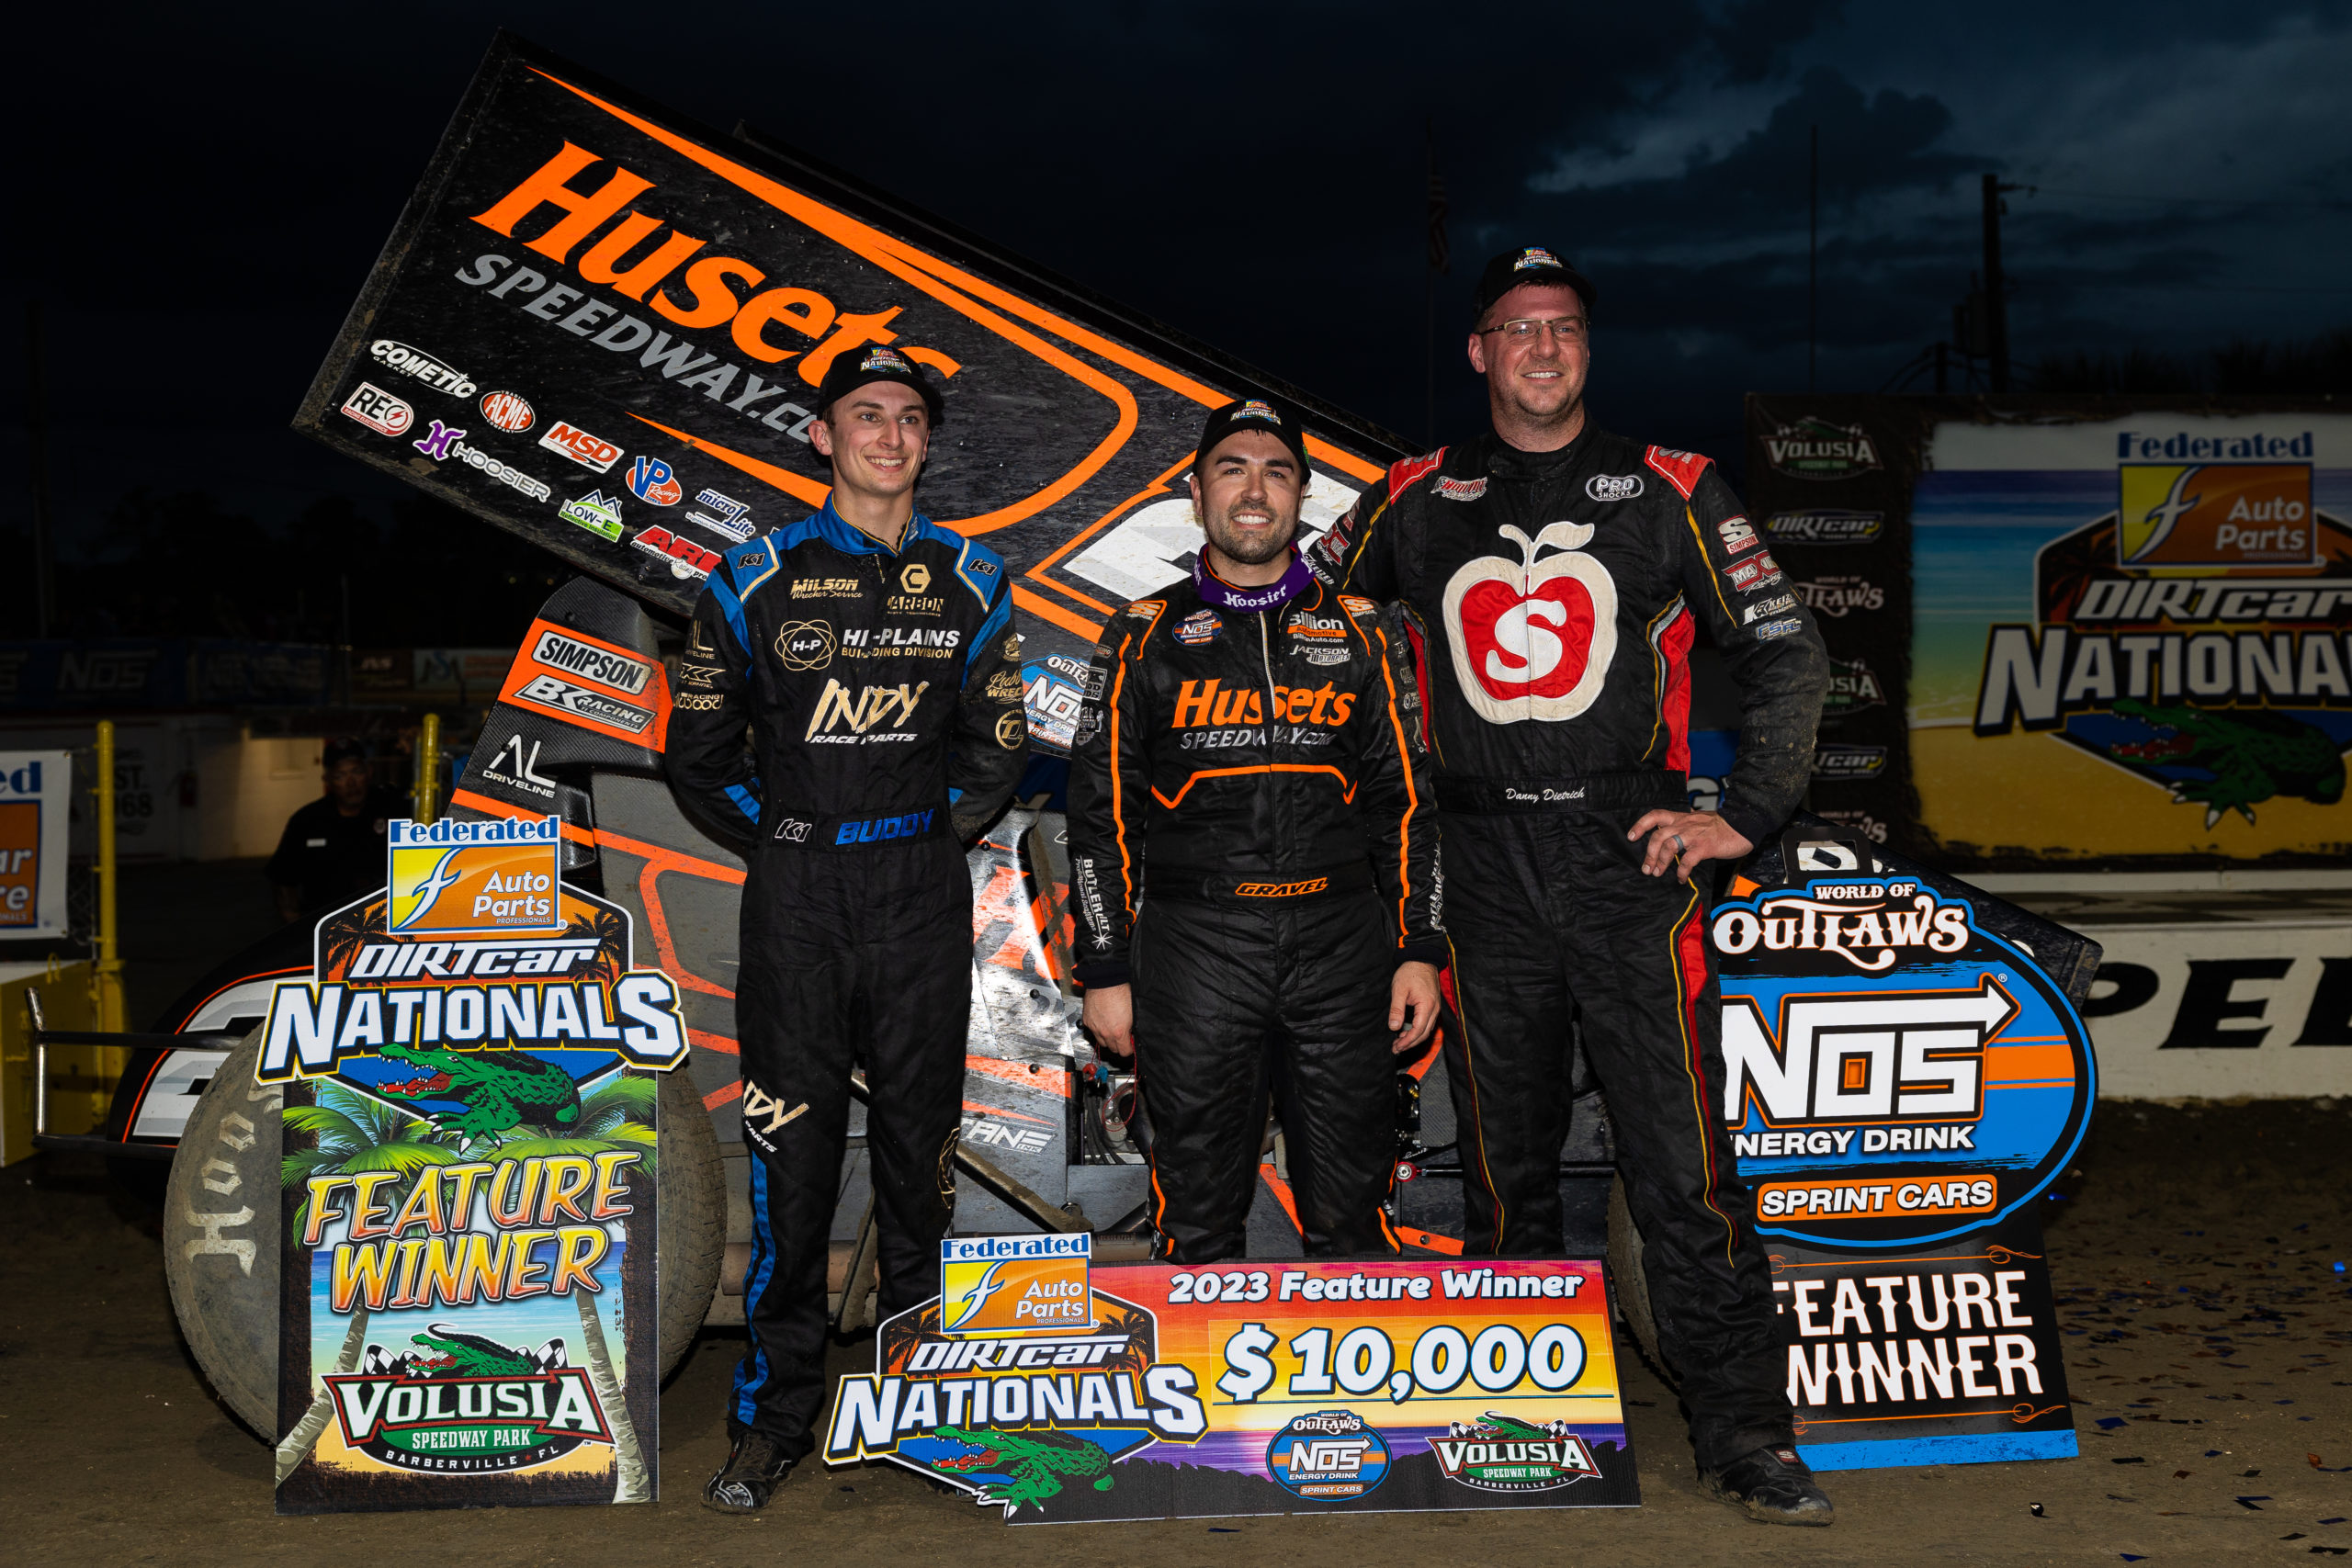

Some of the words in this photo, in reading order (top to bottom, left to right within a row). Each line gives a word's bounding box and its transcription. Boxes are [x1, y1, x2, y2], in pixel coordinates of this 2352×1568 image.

[370, 340, 477, 398] COMETIC
[485, 394, 530, 430] ACME
[548, 424, 618, 463] MSD
[1768, 438, 1876, 464] VOLUSIA
[2118, 432, 2313, 458] Federated
[453, 441, 550, 502] HOOSIER
[633, 457, 672, 499] VP
[649, 485, 682, 501] Racing
[1596, 477, 1634, 493] PRO
[1598, 490, 1631, 499] SHOCKS
[2227, 495, 2306, 523] Auto
[560, 511, 591, 531] Reflective
[586, 523, 616, 541] Insulation
[1772, 514, 1876, 539] DIRTcar
[2215, 524, 2307, 551] Parts
[631, 540, 674, 566] automotive
[1729, 536, 1758, 553] SIMPSON
[737, 553, 765, 570] K1
[968, 558, 998, 576] K1
[1222, 584, 1287, 608] Hoosier
[2073, 579, 2352, 620] DIRTcar
[1182, 622, 1215, 635] NOS
[792, 639, 821, 651] H-P
[904, 647, 955, 659] DIVISION
[1289, 645, 1350, 656] JACKSON
[540, 637, 644, 690] SIMPSON
[1976, 626, 2352, 728] NATIONA
[577, 696, 645, 724] RACING
[805, 678, 930, 742] INDY
[1171, 678, 1357, 728] Husets
[809, 736, 860, 744] RACE
[861, 733, 919, 745] PARTS
[483, 770, 555, 798] DRIVELINE
[1506, 788, 1540, 804] Danny
[1544, 786, 1585, 802] Dietrich
[390, 817, 558, 843] Federated
[775, 818, 812, 842] K1
[835, 808, 935, 846] BUDDY
[482, 870, 550, 893] Auto
[1236, 877, 1329, 897] GRAVEL
[1814, 885, 1885, 901] WORLD
[1889, 882, 1917, 898] OF
[472, 894, 550, 919] Parts
[496, 916, 551, 925] PROFESSIONALS
[349, 938, 601, 979] DIRTcar
[262, 975, 682, 1072] NATIONALS
[1722, 979, 2012, 1122] NOS
[1732, 1131, 1856, 1156] NERGY
[1862, 1125, 1975, 1153] DRINK
[304, 1151, 642, 1246] FEATURE
[1761, 1184, 1893, 1217] SPRINT
[1896, 1179, 1994, 1210] CARS
[943, 1235, 1090, 1259] Federated
[331, 1225, 610, 1314] WINNER
[1024, 1279, 1083, 1299] Auto
[1169, 1271, 1270, 1303] 2023
[1278, 1270, 1430, 1302] Feature
[1441, 1268, 1584, 1299] Winner
[1015, 1299, 1084, 1320] Parts
[1036, 1316, 1085, 1325] PROFESSIONALS
[907, 1335, 1129, 1371] DIRTcar
[336, 1375, 602, 1439] VOLUSIA
[831, 1367, 1207, 1451] NATIONALS
[412, 1429, 488, 1450] SPEEDWAY
[492, 1428, 531, 1448] PARK
[386, 1450, 518, 1470] BARBERVILLE
[537, 1446, 560, 1460] FL
[1289, 1438, 1373, 1472] NOS
[1436, 1438, 1592, 1472] VOLUSIA
[1288, 1472, 1328, 1481] ENERGY
[1329, 1472, 1359, 1480] DRINK
[1469, 1477, 1546, 1490] BARBERVILLE
[1556, 1476, 1569, 1484] FL
[1483, 1468, 1527, 1478] SPEEDWAY
[1530, 1467, 1552, 1477] PARK
[1301, 1486, 1336, 1495] SPRINT
[1336, 1485, 1363, 1494] CARS
